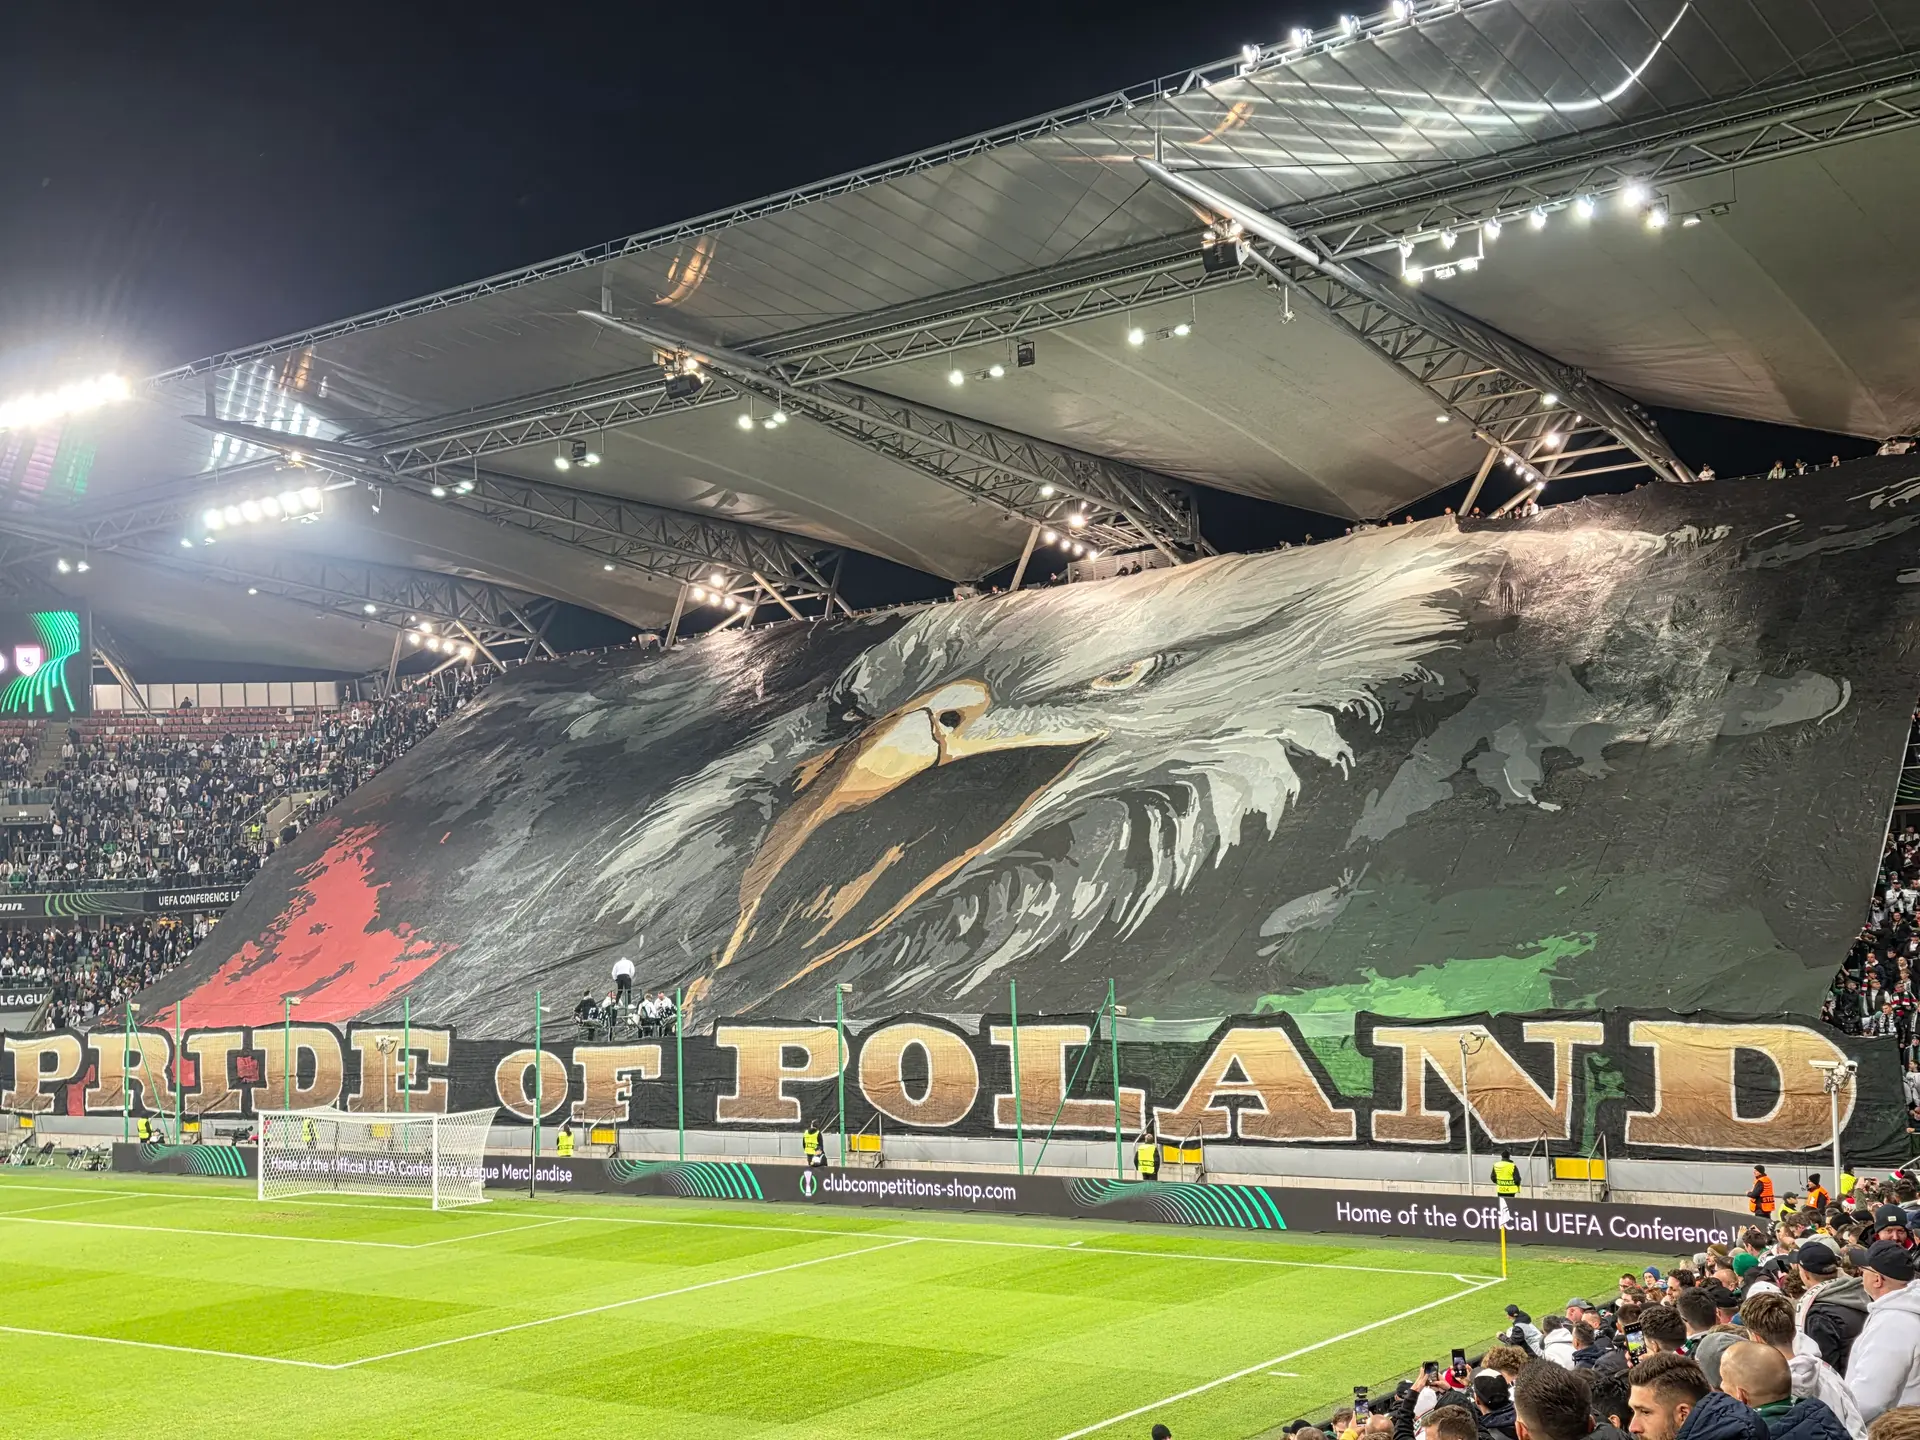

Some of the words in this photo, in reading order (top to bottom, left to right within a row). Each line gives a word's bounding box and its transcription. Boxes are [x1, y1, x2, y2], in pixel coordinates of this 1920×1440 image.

[158, 894, 179, 907] UEFA
[179, 890, 230, 905] CONFERENCE
[2, 1025, 451, 1115] PRIDE
[715, 1020, 1858, 1153] POLAND
[271, 1155, 299, 1171] Home
[300, 1156, 312, 1171] of
[312, 1156, 329, 1172] the
[368, 1159, 396, 1176] UEFA
[399, 1160, 458, 1178] Confernce
[460, 1161, 499, 1183] League
[822, 1173, 1017, 1203] clubcompetitions-shop.com
[1336, 1201, 1392, 1224] Home
[1397, 1203, 1419, 1226] of
[1424, 1204, 1458, 1228] the
[1463, 1206, 1539, 1233] Official
[1545, 1211, 1604, 1237] UEFA
[1609, 1216, 1729, 1245] Conference
